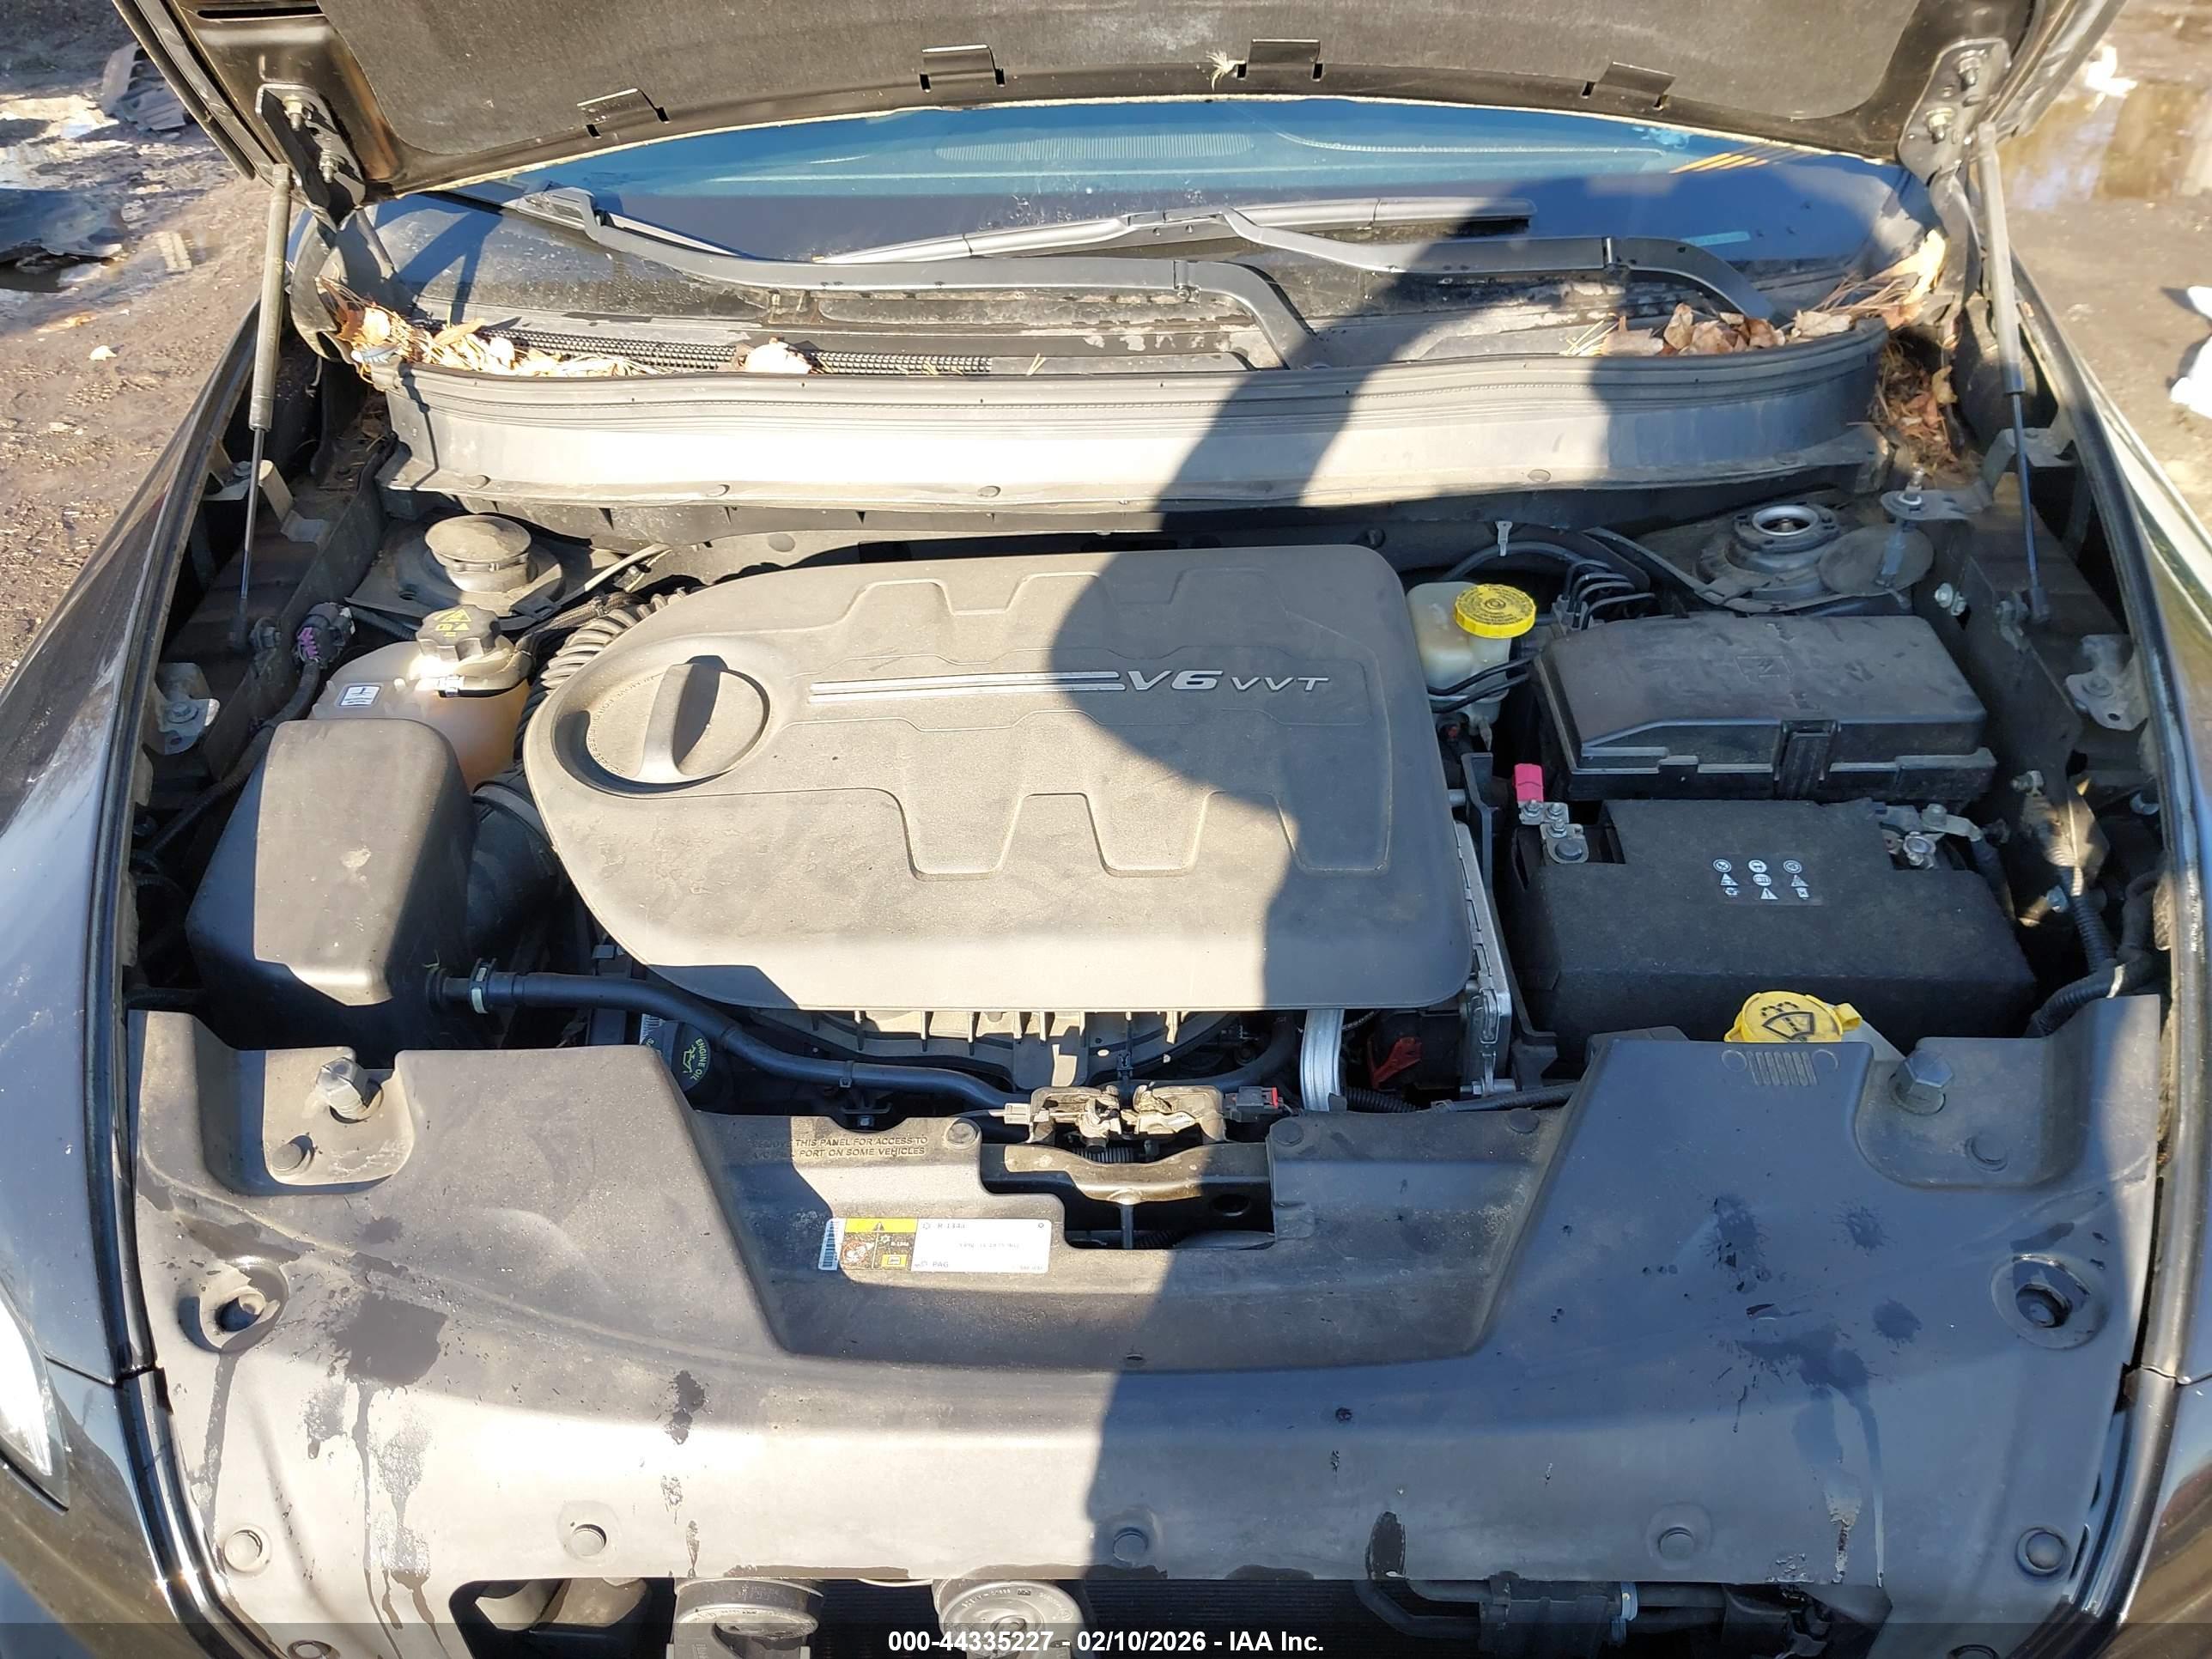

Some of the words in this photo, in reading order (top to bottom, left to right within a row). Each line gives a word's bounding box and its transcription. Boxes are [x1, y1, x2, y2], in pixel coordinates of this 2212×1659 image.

[1127, 670, 1223, 690] V6
[1231, 677, 1329, 690] VVT
[696, 1038, 708, 1067] ENGINE
[690, 1068, 702, 1081] OIL
[876, 1137, 912, 1146] ACCESS
[915, 1136, 928, 1145] TO
[878, 1147, 925, 1156] VEHICLES
